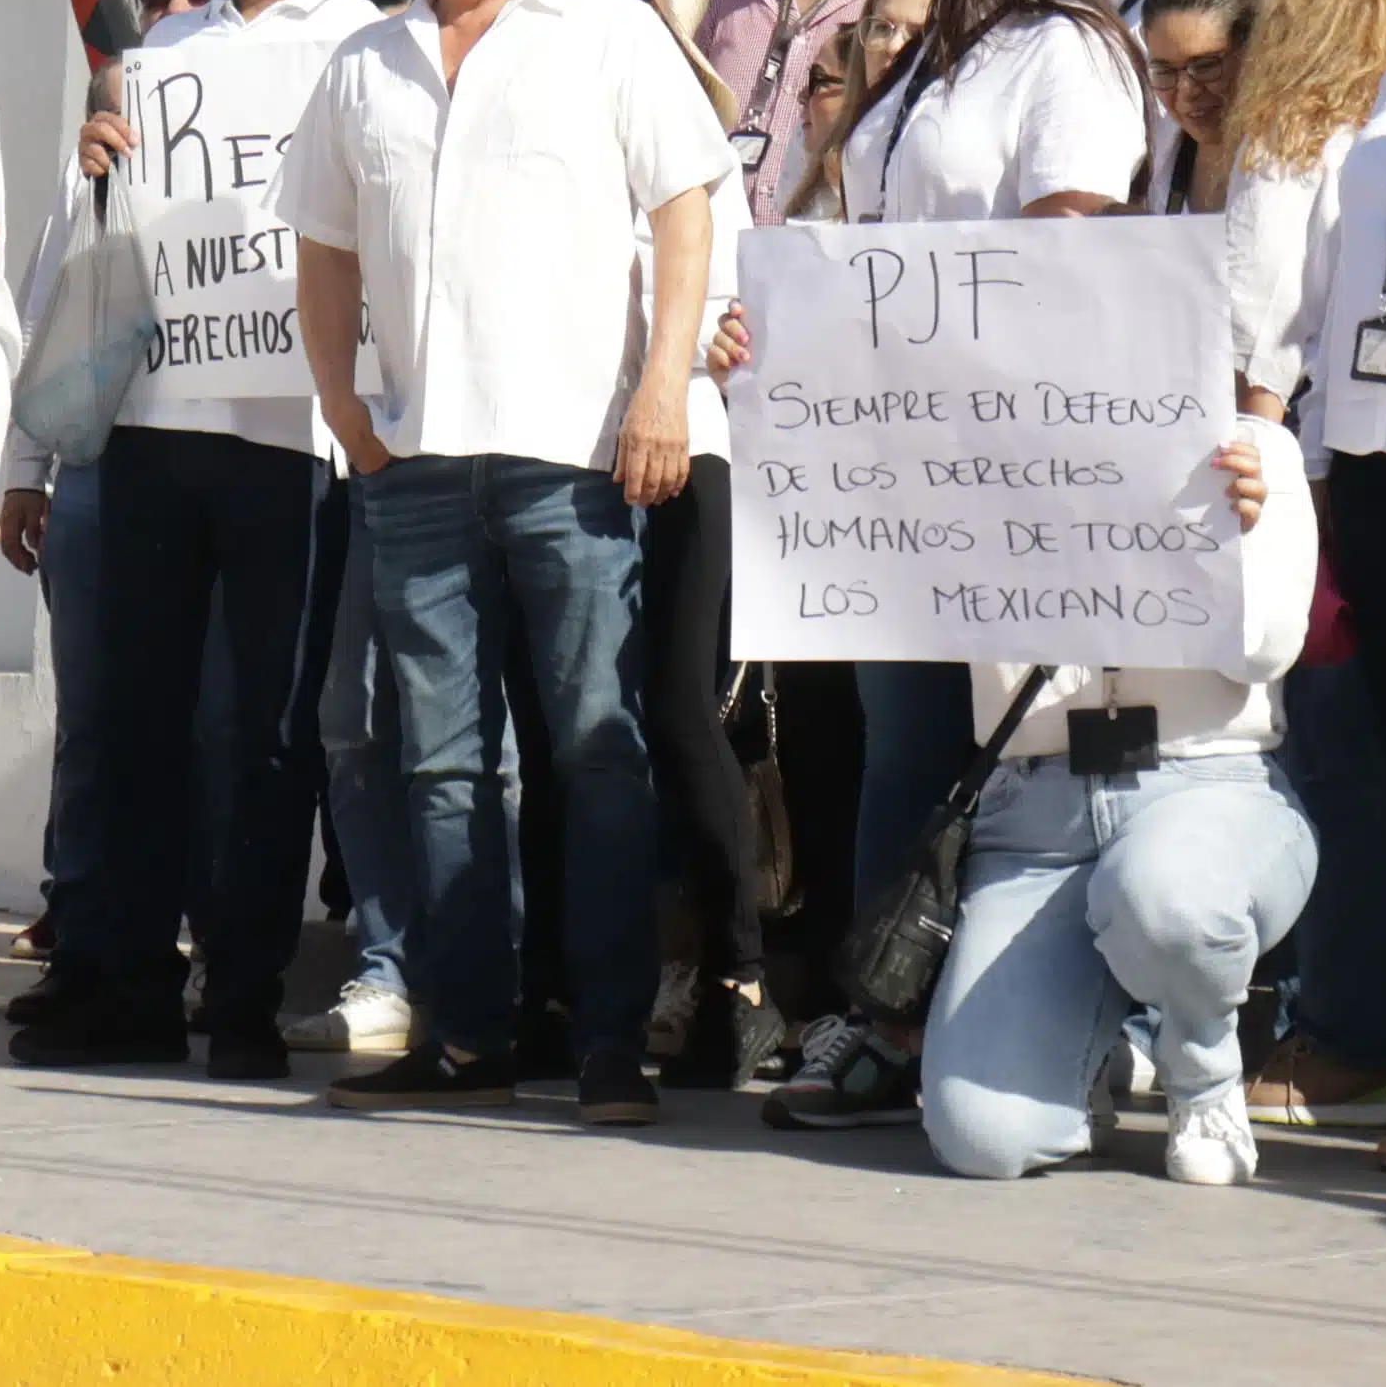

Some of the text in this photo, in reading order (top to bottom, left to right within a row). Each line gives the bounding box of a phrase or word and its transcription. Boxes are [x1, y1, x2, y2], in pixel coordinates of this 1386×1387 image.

[153, 227, 301, 297] A NUEST
[849, 247, 1025, 349] PJF
[147, 308, 297, 374] DERECHOS
[769, 380, 1207, 430] SIEMPRE EN DEFENSA
[758, 457, 1124, 495] DE LOS DERECHOS
[777, 511, 1220, 560] HUMANOS DE TODOS
[799, 580, 1211, 627] LOS MEXICANOS
